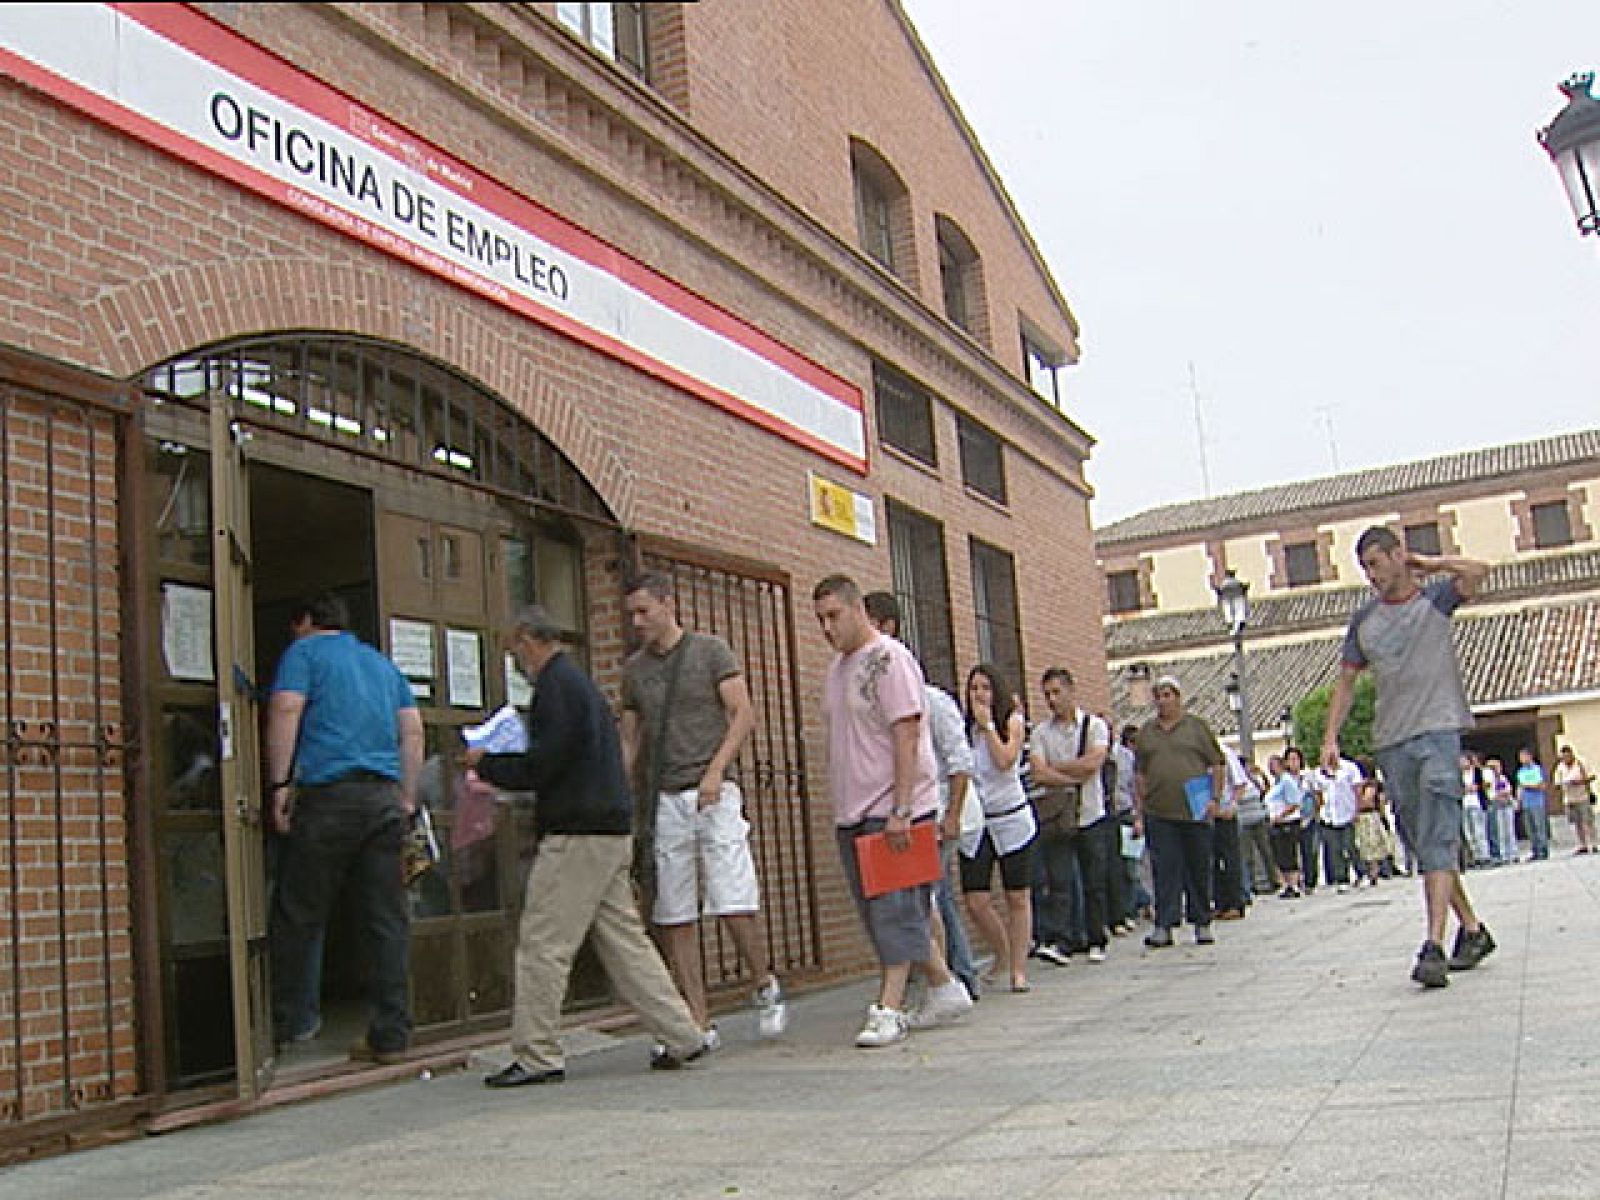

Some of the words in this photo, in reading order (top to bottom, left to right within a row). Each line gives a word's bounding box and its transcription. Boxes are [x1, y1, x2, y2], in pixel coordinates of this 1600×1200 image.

[210, 91, 383, 211] OFICINA
[392, 179, 437, 238] DE
[446, 209, 568, 301] EMPLEO
